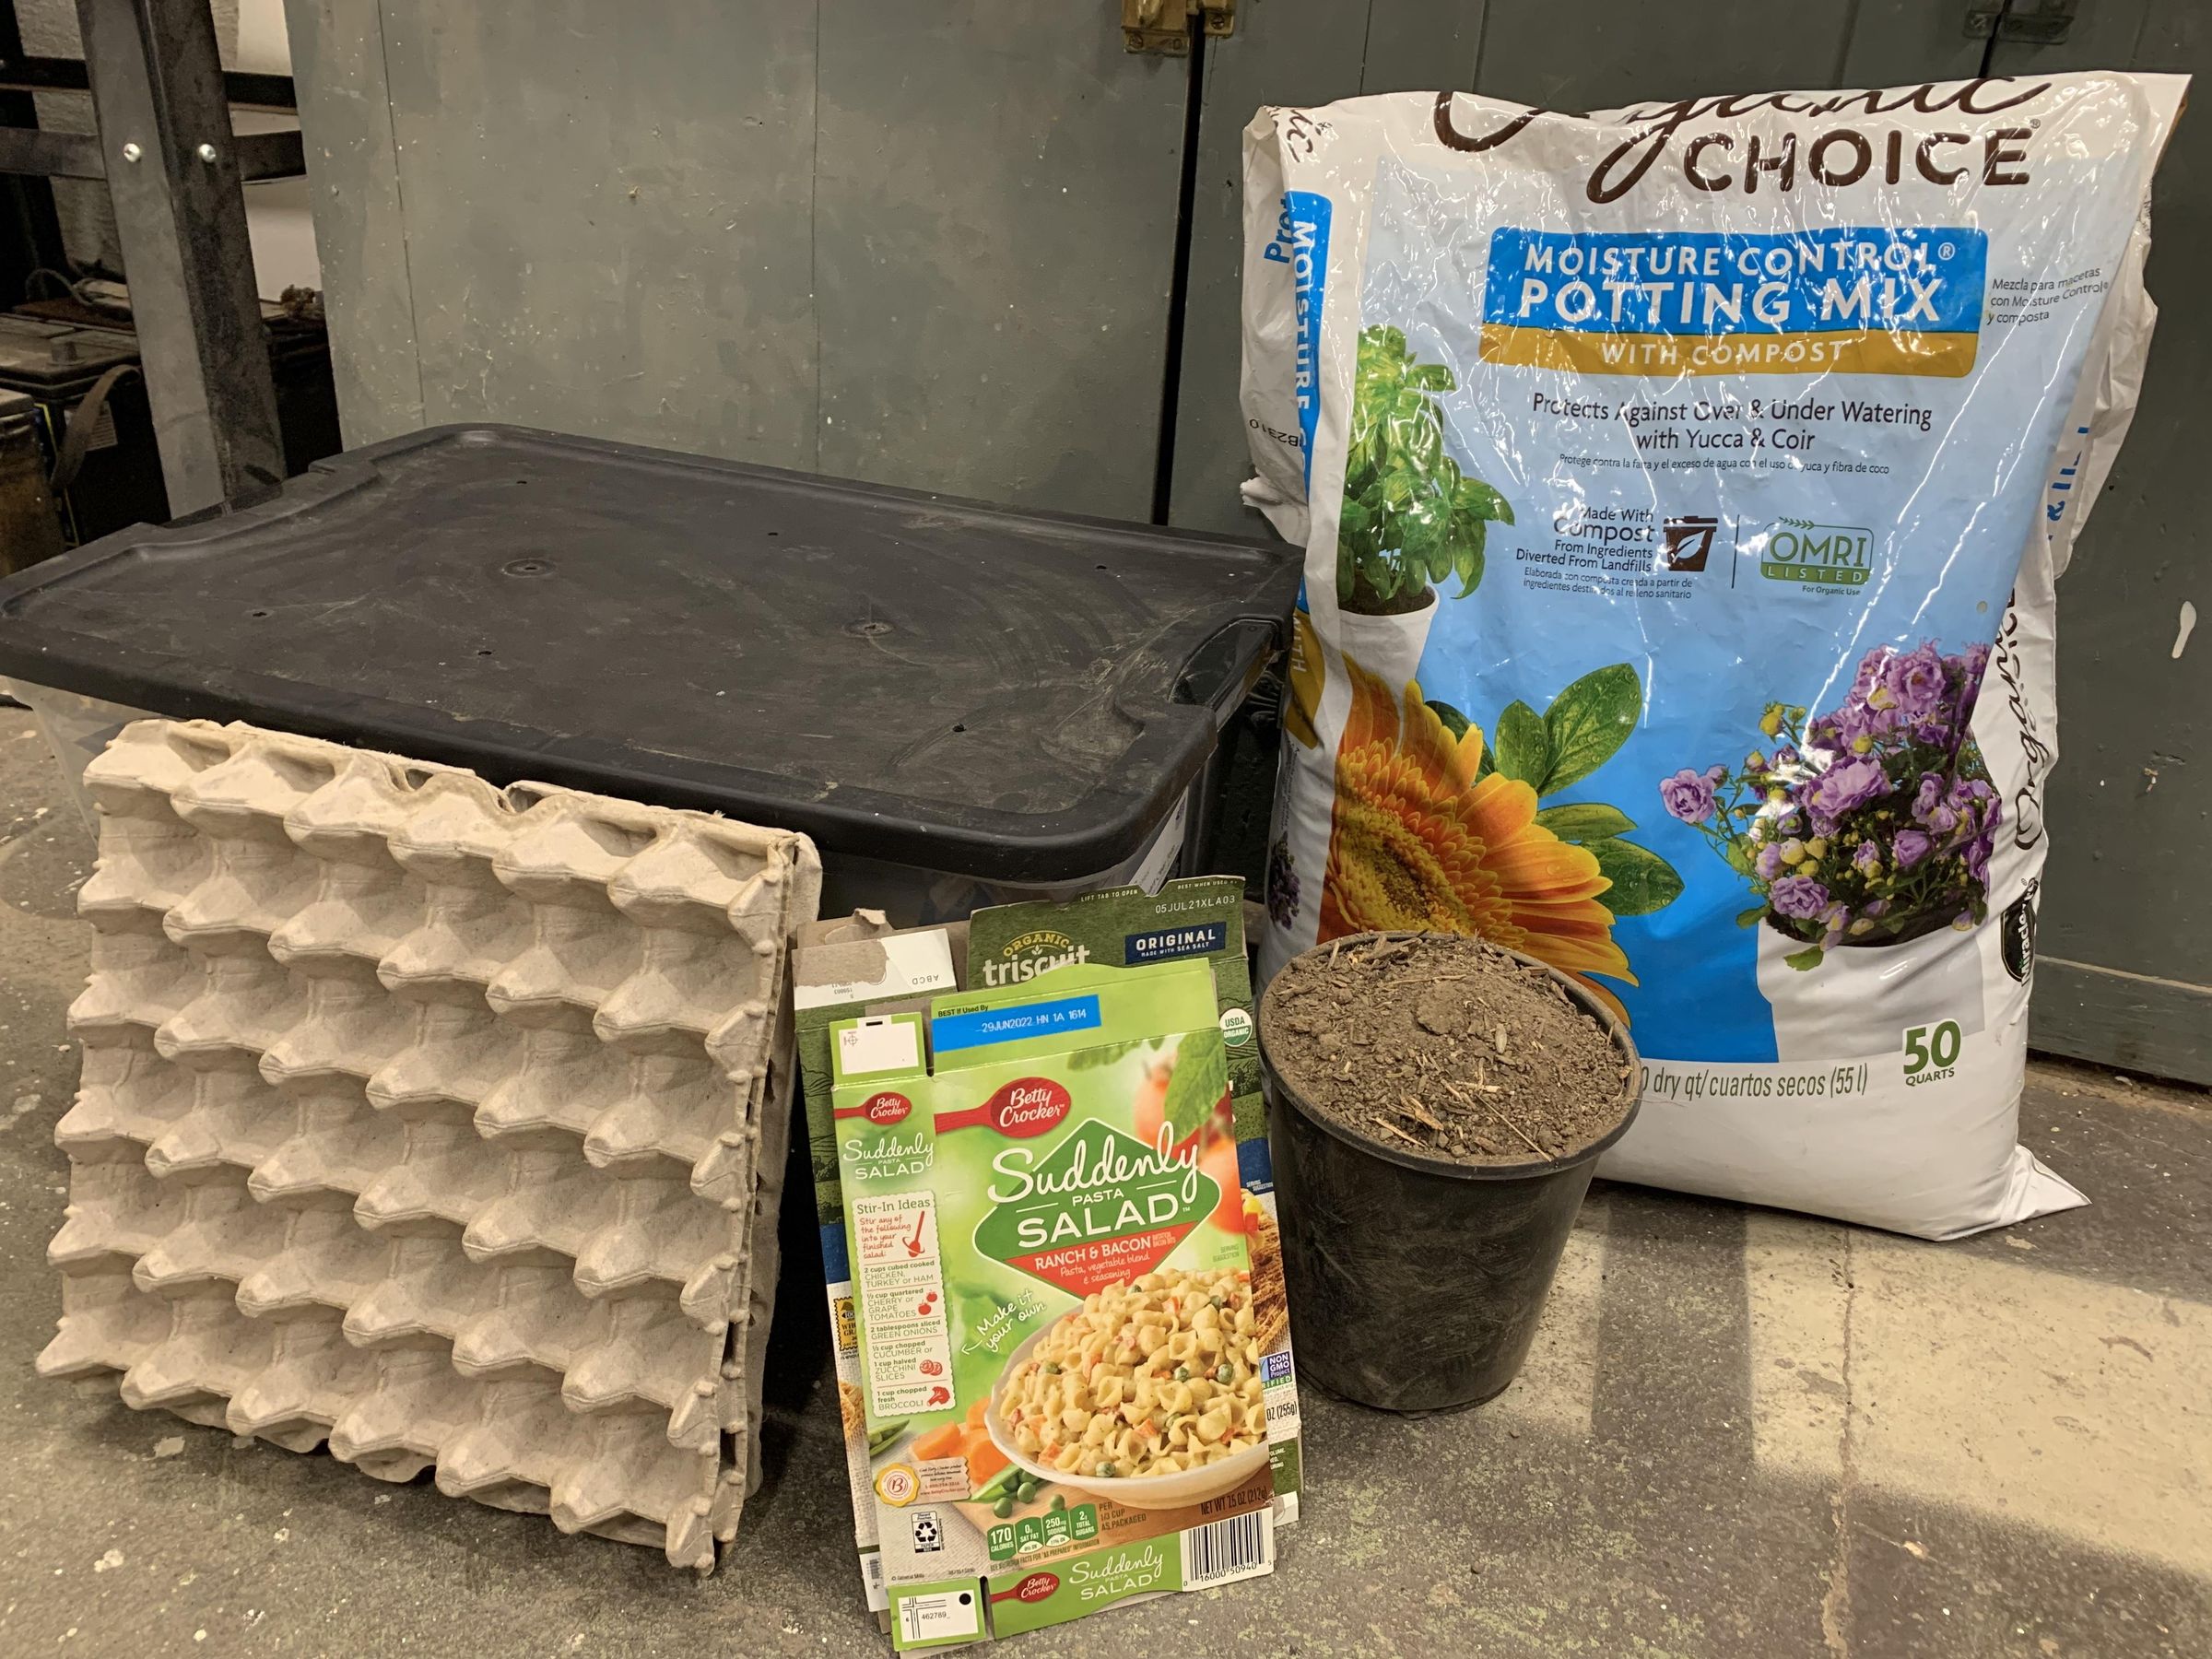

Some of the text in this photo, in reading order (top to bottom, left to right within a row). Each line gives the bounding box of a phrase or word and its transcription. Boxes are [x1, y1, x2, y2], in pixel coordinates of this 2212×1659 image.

[1524, 243, 1722, 276] MOISTURE
[1992, 267, 2100, 294] Mezcla para macetas
[1521, 277, 1944, 324] POTTING MIX
[1991, 296, 2010, 307] con
[1293, 220, 1317, 410] MOISTURE
[1996, 311, 2050, 326] composta
[1602, 341, 1847, 366] WITH COMPOST
[1533, 392, 1933, 432] Protects Against Over & Under Watering
[1636, 427, 1816, 450] with Yucca & Coir
[1559, 453, 1592, 468] Protege
[1593, 457, 1622, 468] contra
[1672, 460, 1701, 469] exceso
[1703, 457, 1715, 468] de
[1716, 460, 1737, 470] agua
[1770, 460, 1786, 469] uso
[1832, 462, 1854, 473] fibra
[1869, 465, 1890, 475] coco
[1621, 507, 1654, 523] With
[1553, 516, 1655, 547] Compost
[1554, 539, 1653, 559] From Ingredients
[1770, 532, 1867, 568] OMRI
[1515, 547, 1652, 572] Diverted From Landfills
[1524, 567, 1562, 581] Elaborada
[1656, 577, 1680, 591] partir
[1681, 578, 1693, 588] de
[1767, 565, 1863, 582] LISTED
[1523, 579, 1692, 599] ingredientes sanitario
[1802, 584, 1861, 595] For Organic Use
[1177, 880, 1211, 890] BEST WHEN
[1080, 888, 1138, 902] LIFT OPEN
[1003, 933, 1070, 958] ORGANIC
[1135, 928, 1217, 951] ORIGINAL
[1141, 949, 1158, 958] MADE
[1193, 942, 1210, 950] SALT
[937, 1004, 989, 1018] BEST Used By
[982, 1009, 1087, 1033] 29JUN2022 HN 1A 1614
[1225, 1016, 1245, 1028] USDA
[1223, 1027, 1250, 1039] ORGANIC
[1903, 1020, 1961, 1076] 50
[1653, 1065, 1826, 1100] dry secos
[1905, 1066, 1956, 1087] QUARTS
[877, 1097, 900, 1110] Betty
[1010, 1087, 1053, 1109] Betty
[842, 1132, 934, 1167] Suddenly
[855, 1160, 924, 1180] SALAD
[987, 1121, 1199, 1204] Suddenly
[1073, 1187, 1124, 1206] PASTA
[856, 1199, 931, 1216] Stir-In Ideas
[859, 1217, 892, 1226] Stir any
[861, 1224, 912, 1234] the following
[862, 1233, 897, 1243] into your
[863, 1241, 894, 1252] finished
[1035, 1248, 1087, 1271] RANCH
[1089, 1246, 1100, 1259] &
[1101, 1236, 1151, 1258] BACON
[888, 1263, 909, 1271] cubed
[910, 1260, 935, 1269] cooked
[1060, 1252, 1150, 1278] Pasta, vegetable blend
[865, 1274, 934, 1288] TURKEY HAM
[1090, 1268, 1132, 1283] seasoning
[889, 1288, 924, 1299] quartered
[867, 1297, 903, 1307] CHERRY
[868, 1304, 899, 1314] GRAPE
[870, 1310, 917, 1321] TOMATOES
[976, 1289, 1033, 1336] Make it
[871, 1326, 938, 1340] GREEN ONIONS
[877, 1323, 919, 1333] tablespoons
[985, 1302, 1047, 1352] your own
[873, 1347, 922, 1359] CUCUMBER
[880, 1340, 925, 1353] cup chopped
[1269, 1353, 1289, 1364] NON
[1269, 1361, 1290, 1371] GMO
[875, 1364, 916, 1375] ZUCCHINI
[876, 1372, 905, 1382] SLICES
[1270, 1368, 1290, 1378] Project
[896, 1386, 927, 1396] chopped
[878, 1400, 924, 1411] BROCCOLI
[1266, 1401, 1298, 1421] OZ (255g)
[1100, 1501, 1113, 1512] PER
[1201, 1486, 1267, 1515] NET WT OZ (212g)
[1111, 1508, 1125, 1519] CUP
[1112, 1512, 1147, 1529] PACKAGED
[1047, 1525, 1067, 1536] SODIUM
[1076, 1526, 1095, 1537] SUGARS
[1077, 1519, 1091, 1529] TOTAL
[990, 1526, 1012, 1546] 170
[1030, 1532, 1040, 1541] FAT
[990, 1542, 1015, 1553] CALORIES
[1069, 1545, 1163, 1584] Suddenly
[1199, 1561, 1257, 1583] 16000 50940
[1027, 1576, 1051, 1590] Betty
[1105, 1573, 1129, 1582] PASTA
[1080, 1573, 1153, 1601] SALAD
